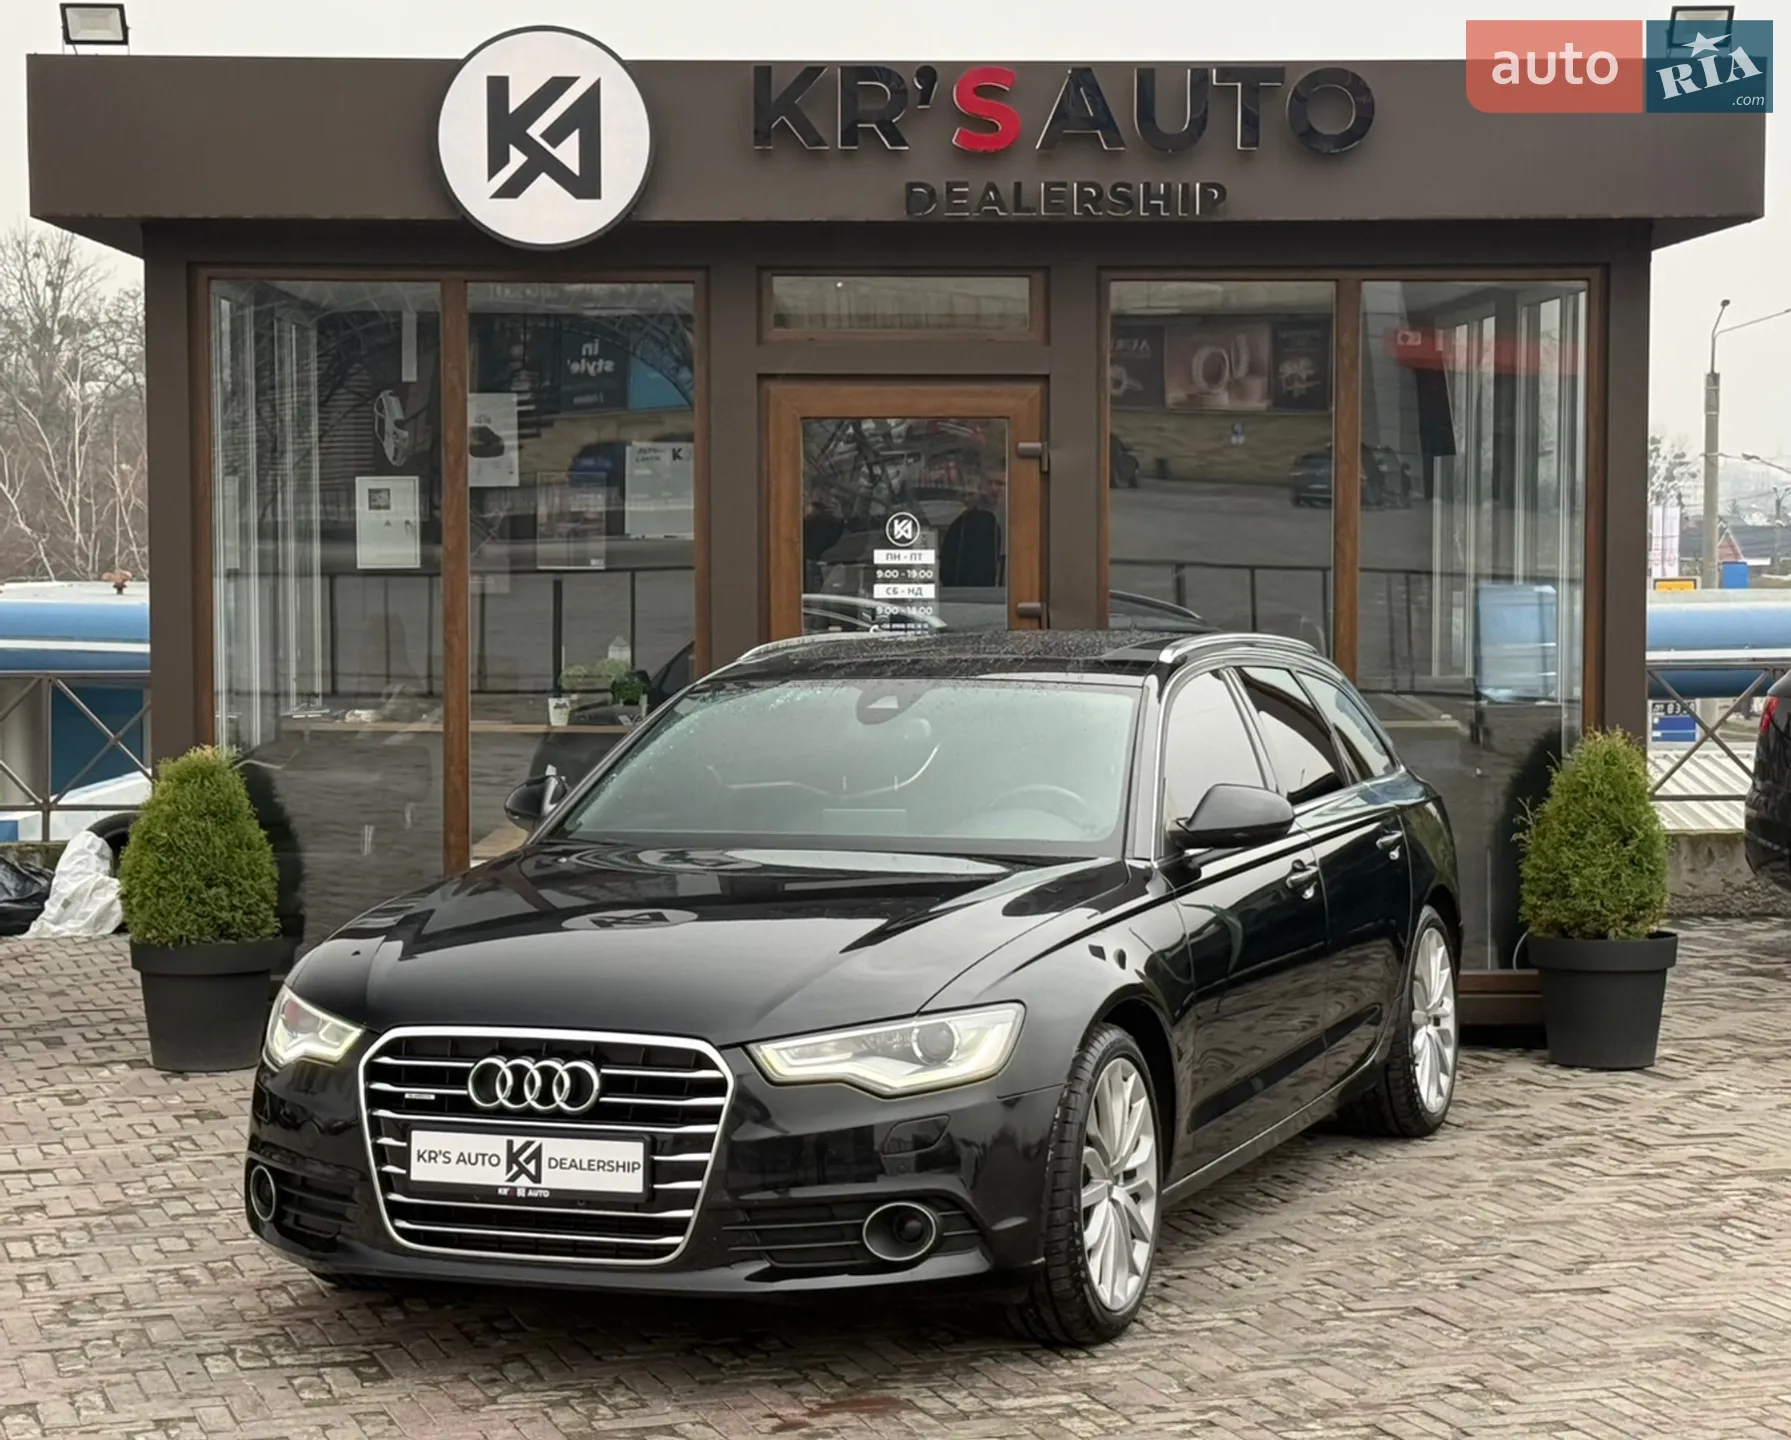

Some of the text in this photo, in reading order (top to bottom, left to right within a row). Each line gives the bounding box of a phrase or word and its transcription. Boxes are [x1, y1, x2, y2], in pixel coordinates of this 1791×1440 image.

[752, 65, 1376, 154] KR'S AUTO
[904, 181, 1228, 217] DEALERSHIP
[885, 552, 901, 561] ПН
[909, 552, 923, 561] ПТ
[907, 587, 923, 596] НД
[416, 1149, 501, 1167] KR'S AUTO
[548, 1157, 641, 1174] DEALERSHIP
